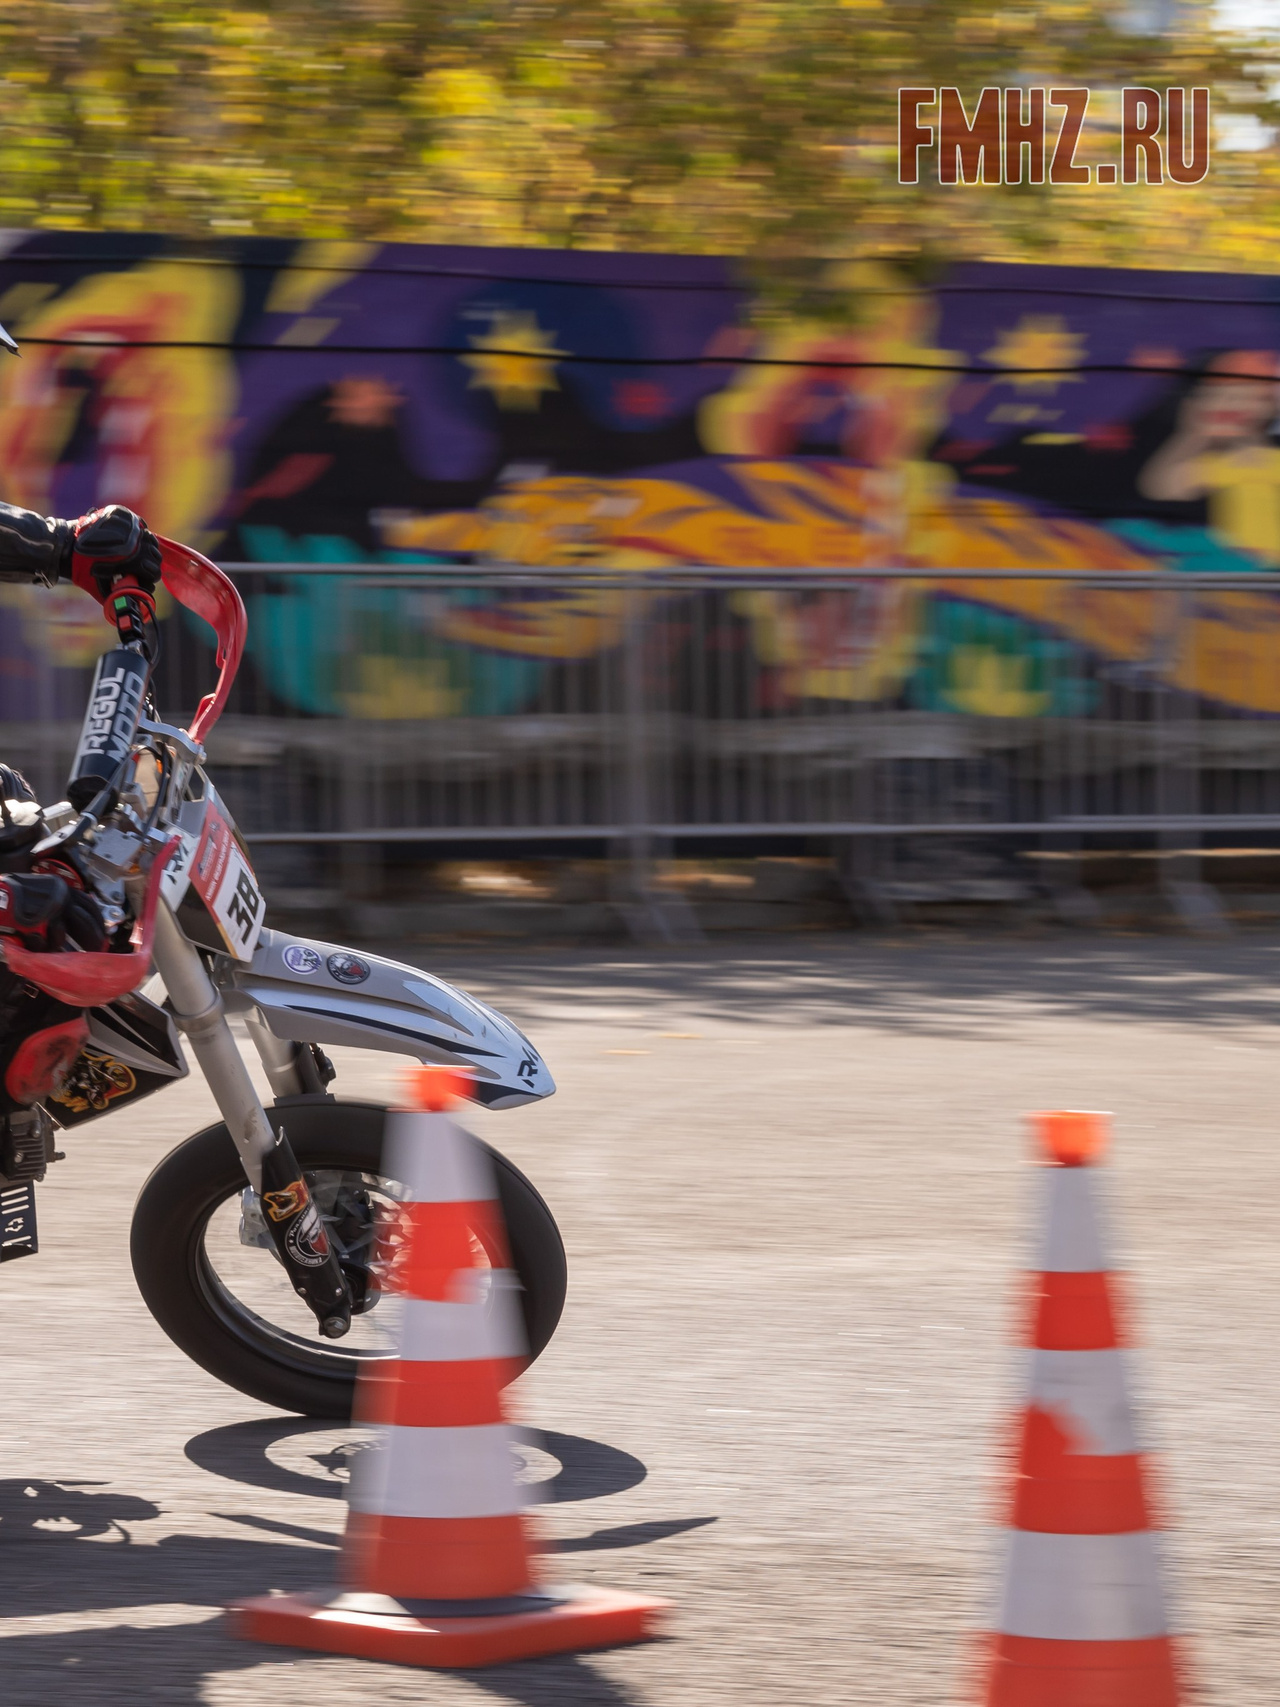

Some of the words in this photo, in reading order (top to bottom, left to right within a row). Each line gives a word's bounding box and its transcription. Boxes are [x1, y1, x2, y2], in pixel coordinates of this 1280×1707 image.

[80, 667, 125, 756] REGUL
[106, 671, 145, 763] MOTO
[226, 867, 260, 946] 38
